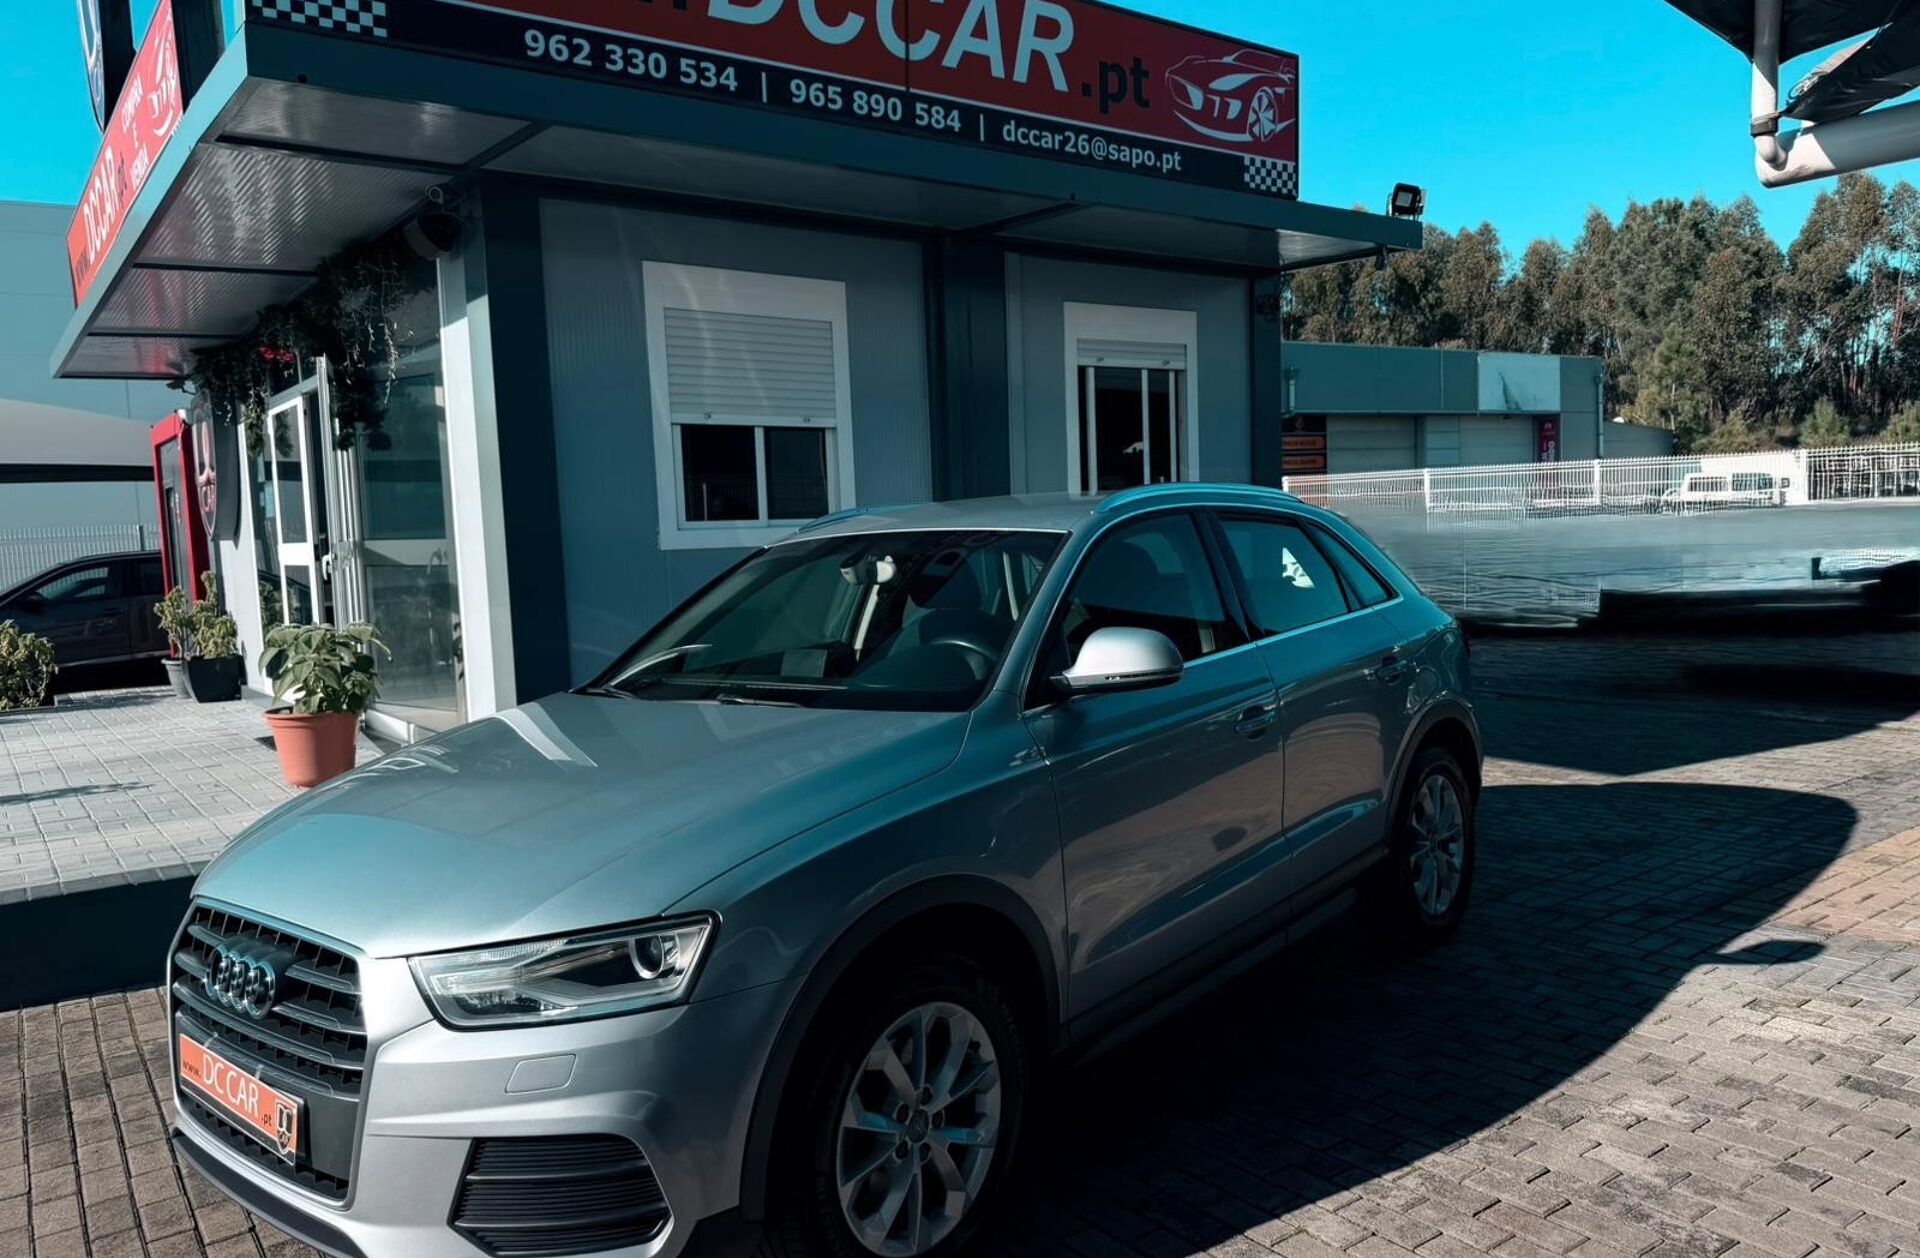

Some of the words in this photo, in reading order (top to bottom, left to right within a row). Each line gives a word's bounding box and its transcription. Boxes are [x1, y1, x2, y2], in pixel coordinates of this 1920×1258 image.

[523, 28, 593, 67] 962
[604, 43, 668, 80] 330
[679, 57, 739, 92] 534
[789, 78, 844, 111] 965
[852, 90, 903, 121] 890
[914, 101, 962, 132] 584
[1002, 119, 1182, 173] dccar26@sapo.pt
[707, 0, 1074, 92] CAR
